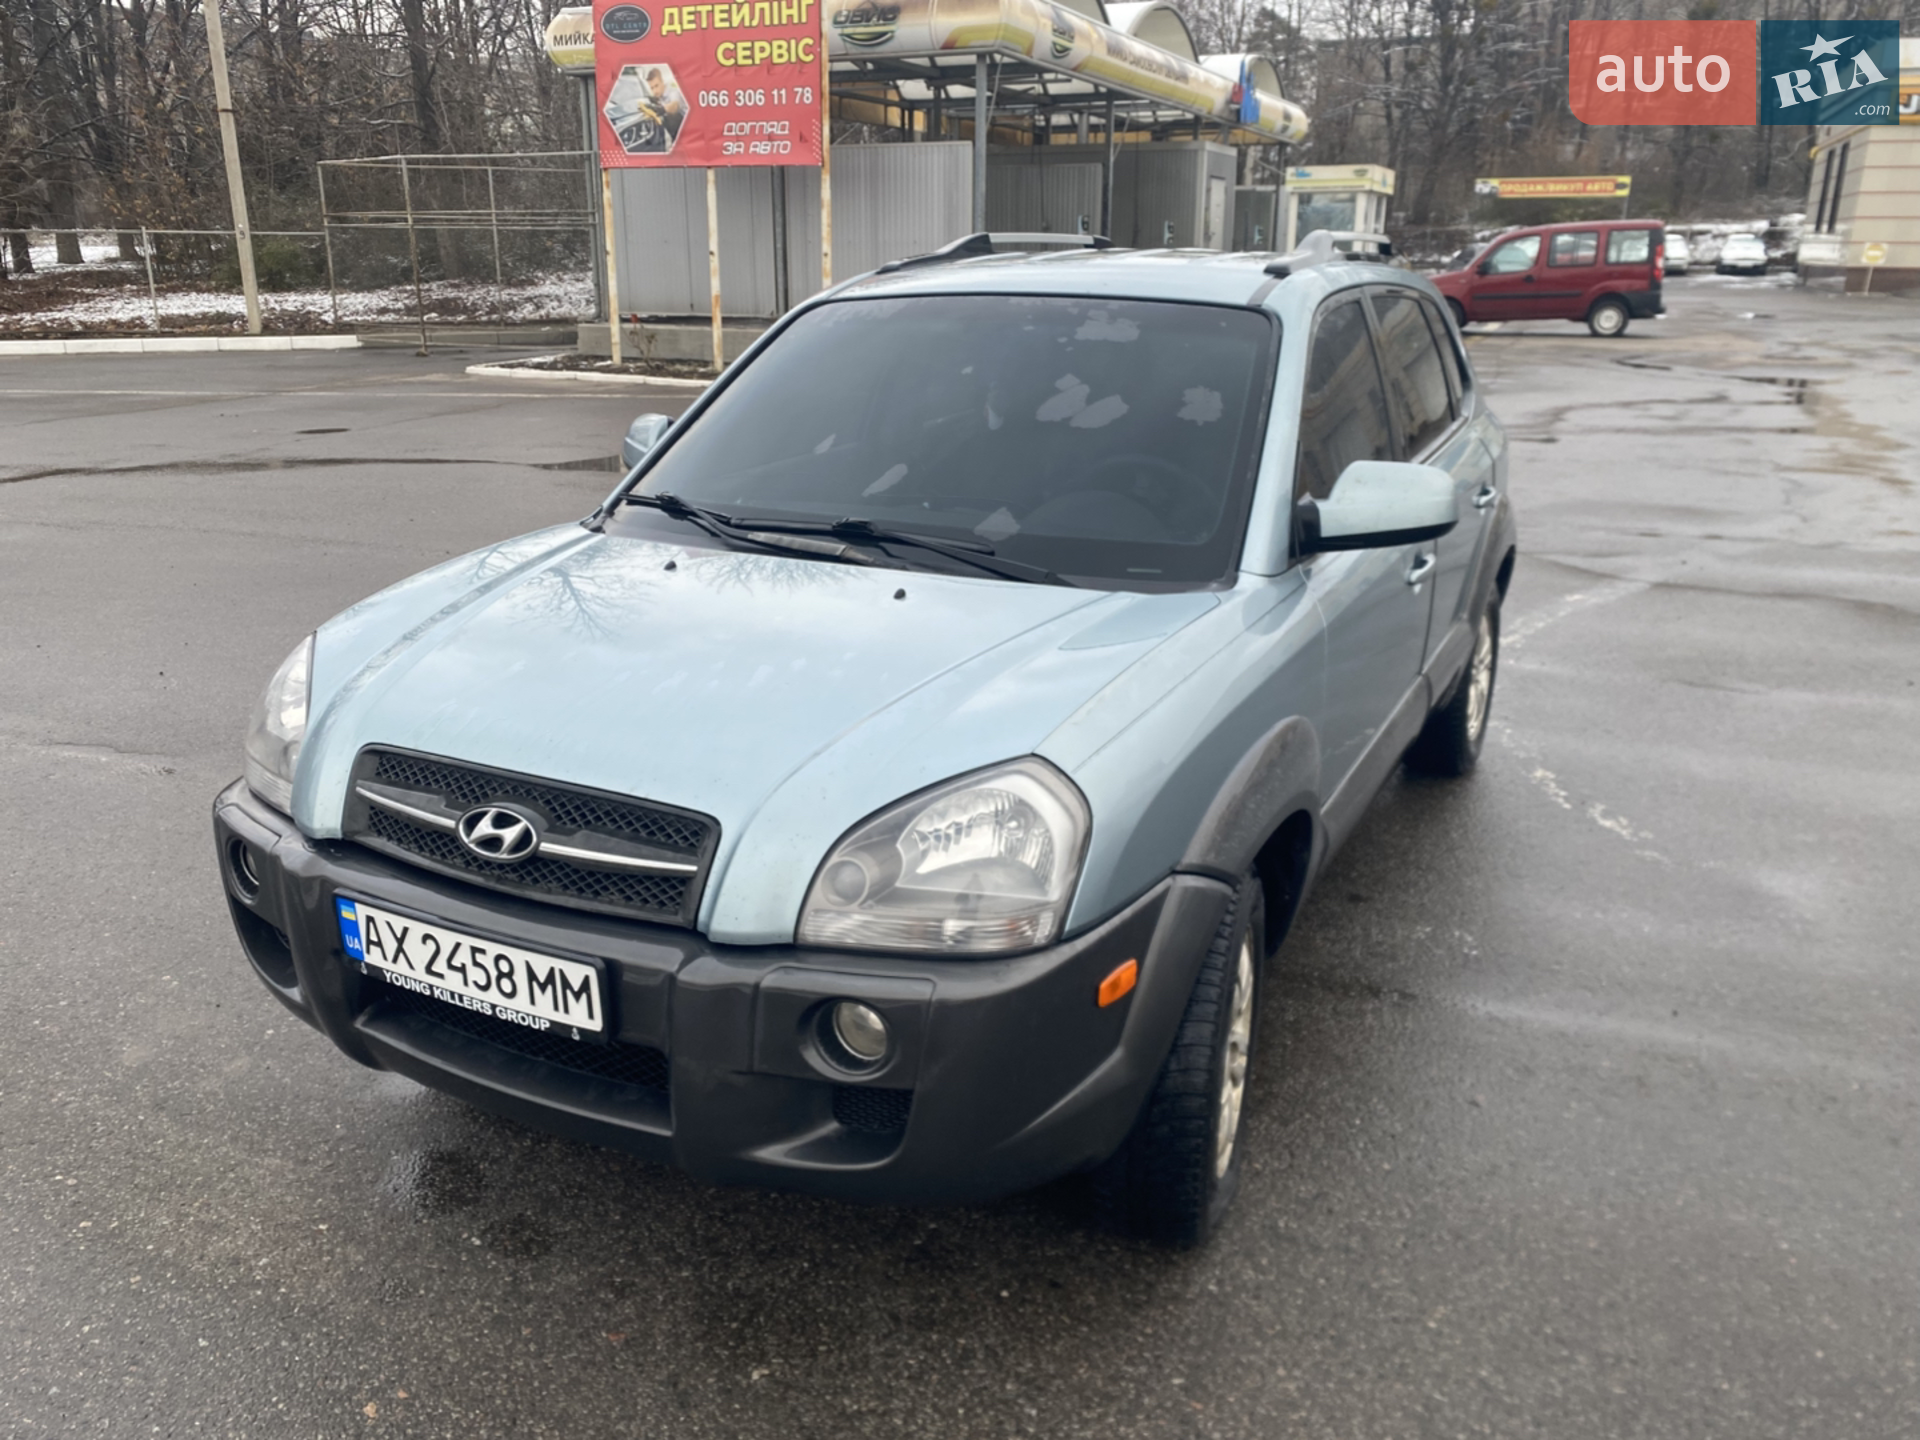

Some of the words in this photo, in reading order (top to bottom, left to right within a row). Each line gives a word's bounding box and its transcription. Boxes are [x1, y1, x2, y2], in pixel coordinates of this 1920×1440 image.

[661, 0, 814, 36] ДЕТЕЙЛІНГ
[716, 37, 815, 66] СЕРВІС
[698, 90, 729, 108] 066
[735, 89, 766, 107] 306
[771, 88, 787, 105] 11
[793, 86, 813, 105] 78
[723, 121, 790, 136] ДОГЛЯД
[722, 142, 745, 155] ЗА
[749, 141, 791, 155] АВТО
[345, 934, 361, 951] UA
[365, 914, 416, 971] AX
[421, 933, 518, 999] 2458
[525, 960, 595, 1021] MM
[382, 970, 431, 996] YOUNG
[432, 986, 493, 1015] KILLERS
[495, 1006, 550, 1031] GROUP
